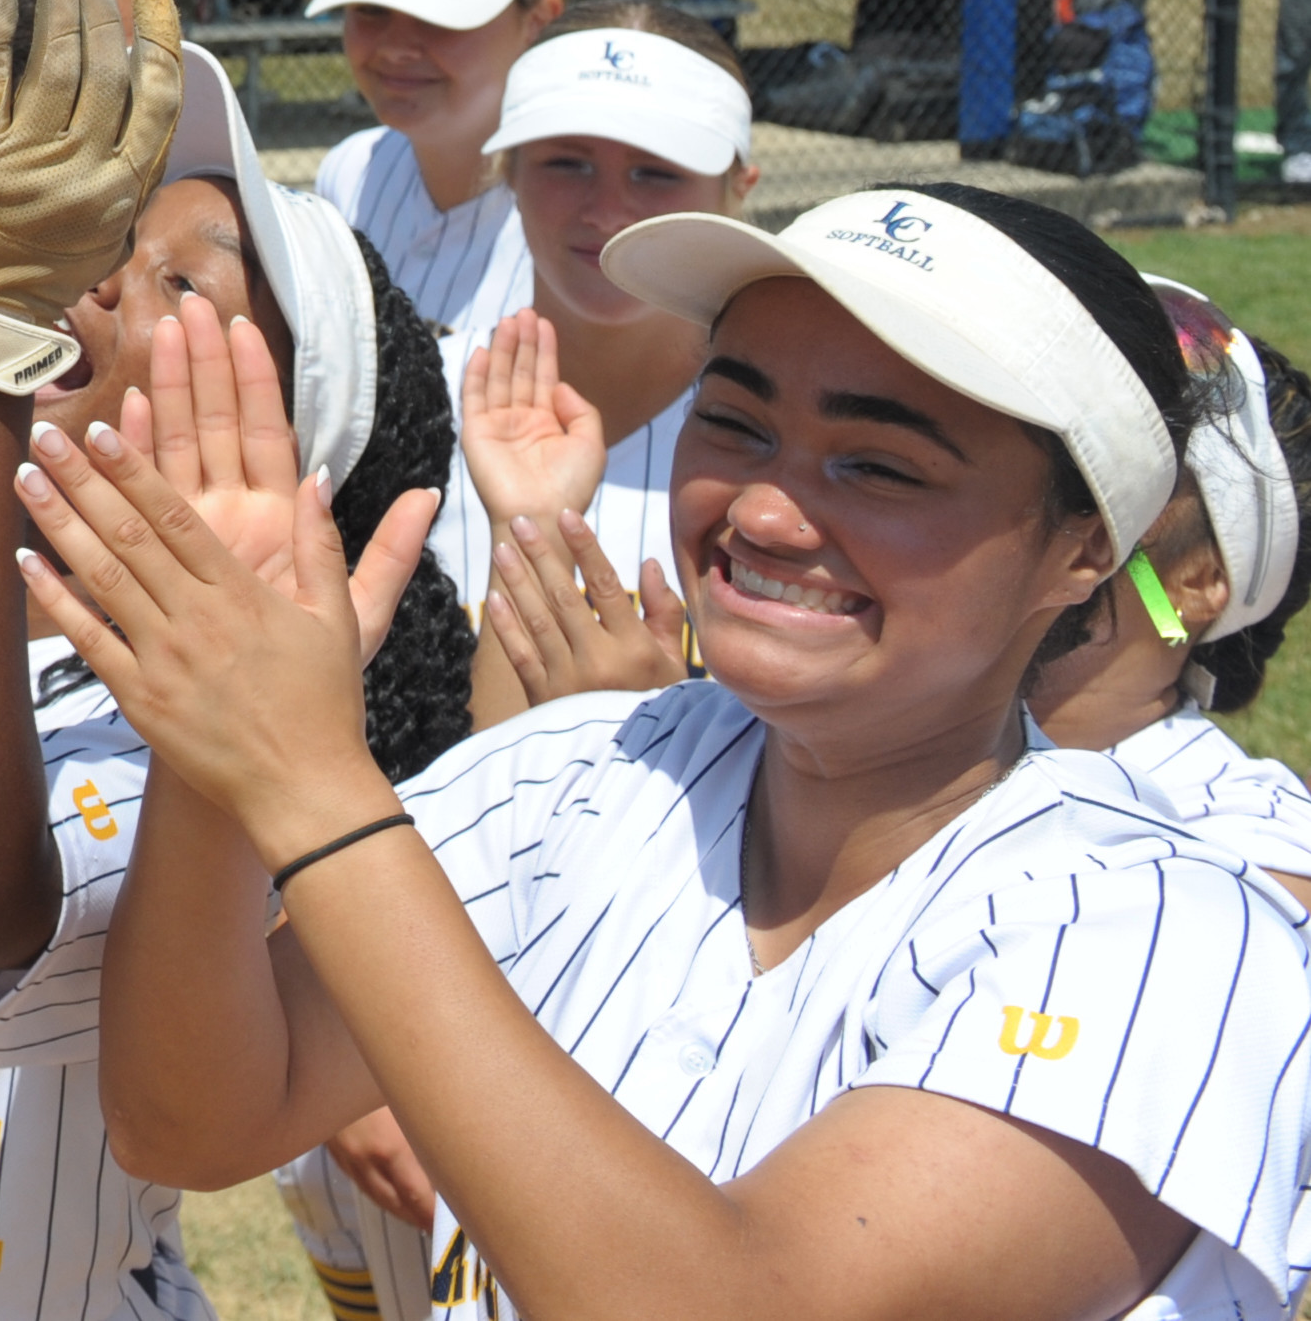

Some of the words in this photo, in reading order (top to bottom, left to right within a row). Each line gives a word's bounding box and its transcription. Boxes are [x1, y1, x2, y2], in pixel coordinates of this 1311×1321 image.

[872, 200, 933, 243] LC
[824, 228, 935, 273] SOFTBALL
[14, 345, 63, 386] PRIMED
